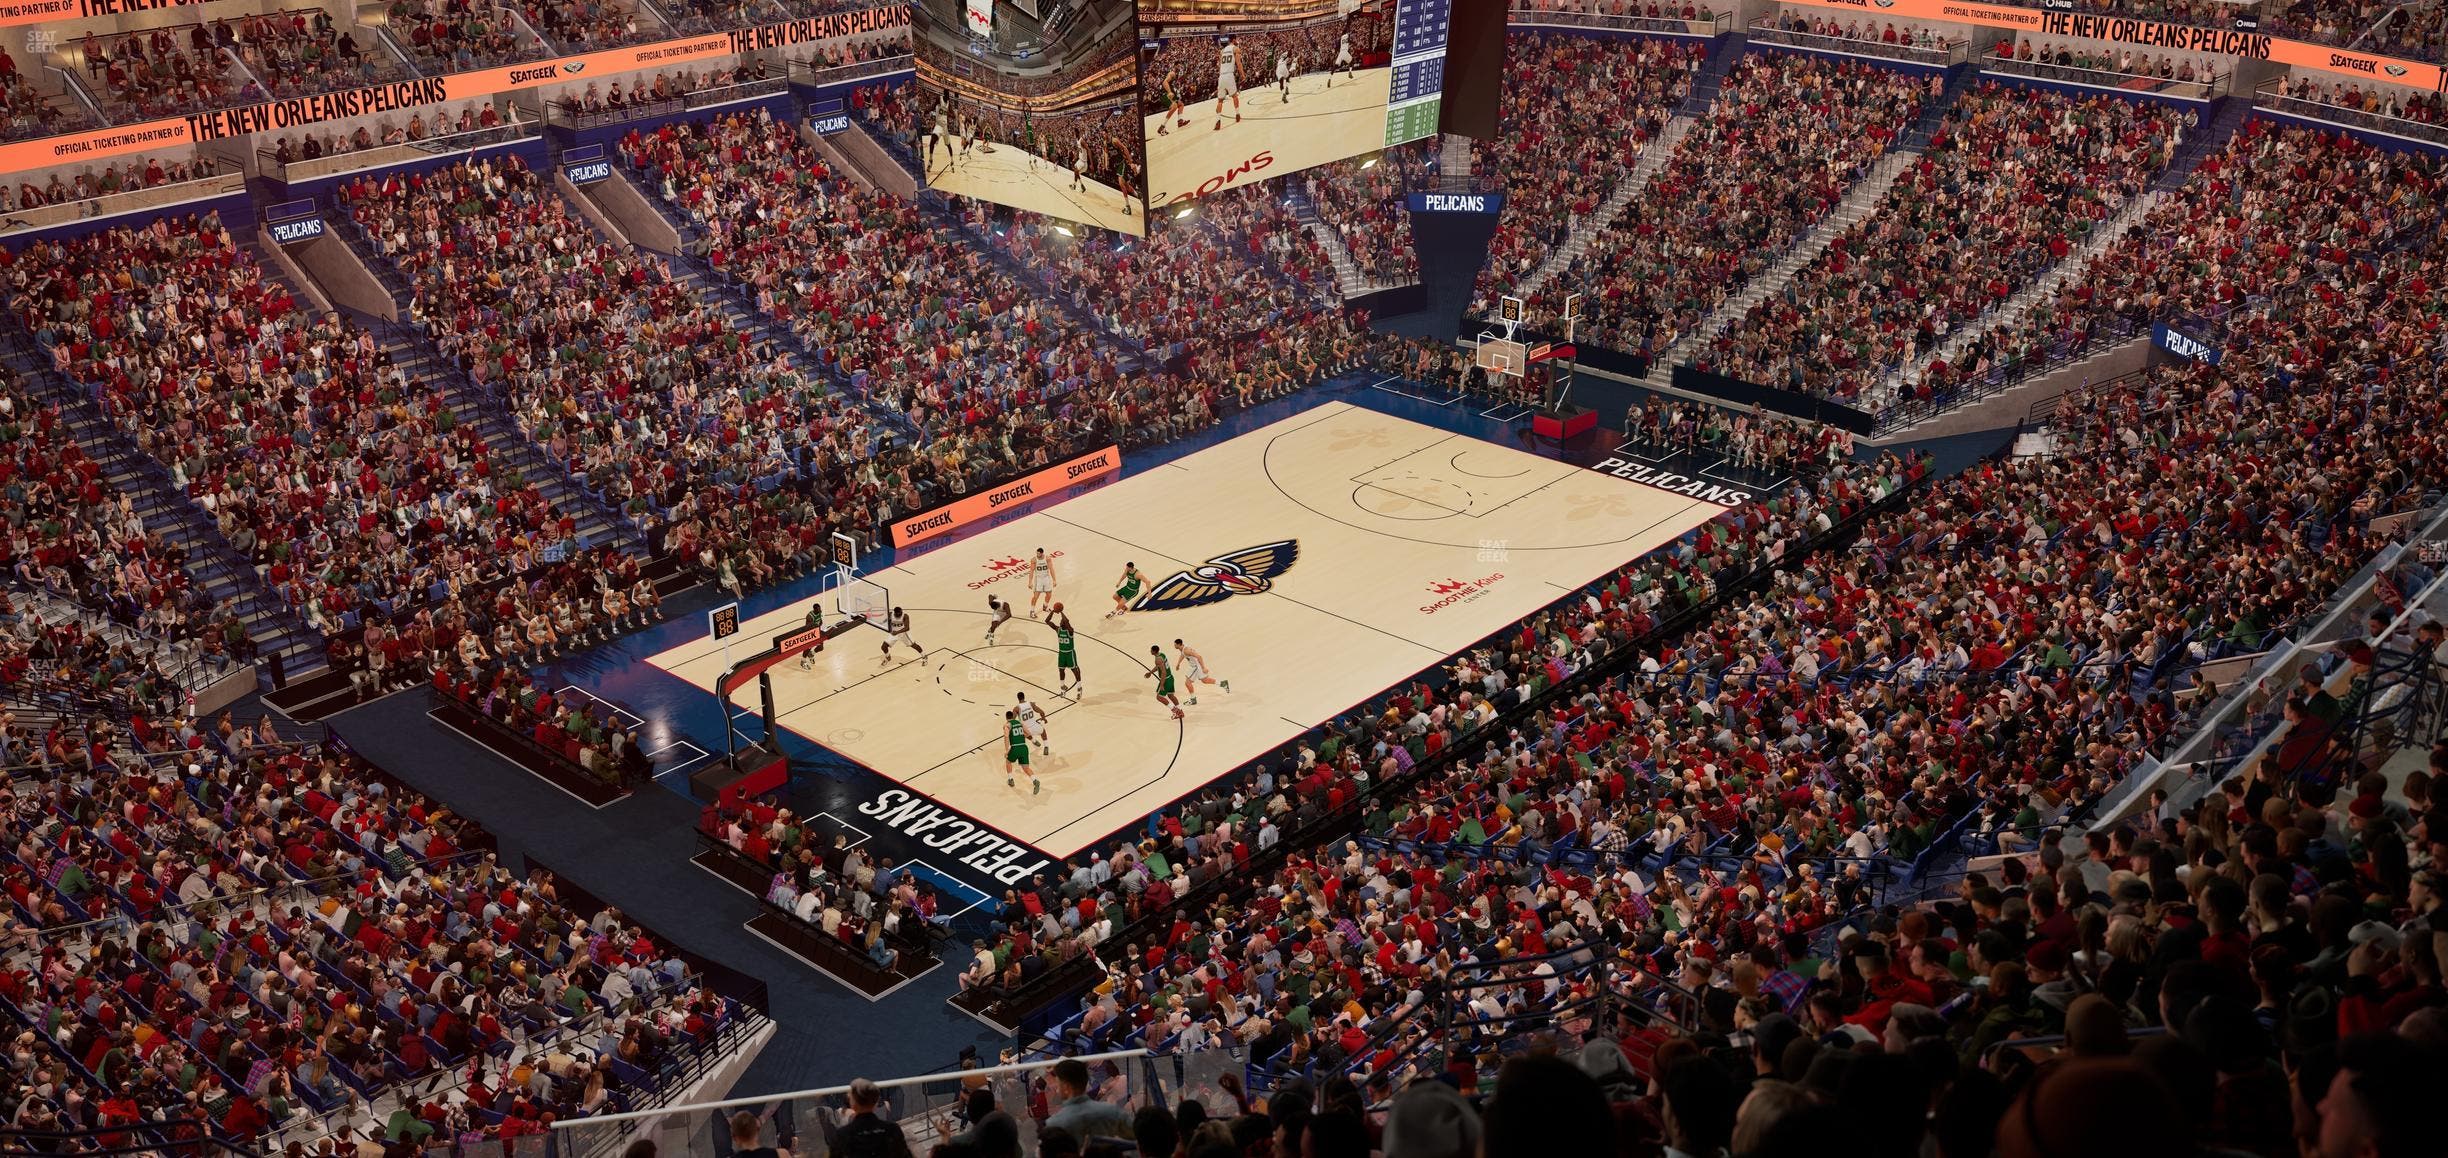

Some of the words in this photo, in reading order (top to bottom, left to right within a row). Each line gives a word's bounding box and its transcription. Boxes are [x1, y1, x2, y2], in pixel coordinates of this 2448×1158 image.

[22, 1, 61, 15] PARTNER
[62, 0, 73, 10] OF
[636, 50, 662, 62] OFFICIAL
[663, 45, 693, 58] TICKETING
[694, 41, 718, 54] PARTNER
[719, 39, 726, 49] OF
[728, 28, 754, 54] THE
[756, 23, 786, 50] NEW
[789, 13, 849, 44] ORLEANS
[851, 4, 911, 35] PELICANS
[1943, 6, 1969, 17] OFFICIAL
[1970, 9, 2002, 21] TICKETING
[2003, 13, 2029, 24] PARTNER
[2030, 16, 2038, 25] OF
[2041, 11, 2069, 35] THE
[2072, 14, 2109, 40] NEW
[2112, 19, 2188, 49] ORLEANS
[2190, 29, 2271, 60] PELICANS
[510, 64, 557, 85] SEATGEEK
[2329, 54, 2377, 74] SEATGEEK
[54, 139, 92, 156] OFFICIAL
[93, 132, 136, 149] TICKETING
[137, 128, 172, 143] PARTNER
[174, 126, 184, 137] OF
[186, 112, 225, 142] THE
[227, 103, 270, 136] NEW
[274, 91, 361, 128] ORLEANS
[362, 77, 447, 114] PELICANS
[1426, 194, 1484, 211] PELICANS
[273, 219, 321, 242] PELICANS
[1505, 308, 1516, 319] 88
[1067, 454, 1109, 479] SEATGEEK
[1592, 457, 1752, 507] PELICANS
[989, 481, 1033, 508] SEATGEEK
[906, 511, 953, 538] SEATGEEK
[837, 548, 850, 563] 88
[968, 563, 1030, 590] SMOOTHIE
[1420, 586, 1478, 615] SMOOTHIE
[719, 619, 733, 636] 88
[784, 630, 817, 649] SEATGEEK
[1022, 711, 1034, 721] 00
[858, 789, 1050, 886] PELICANS
